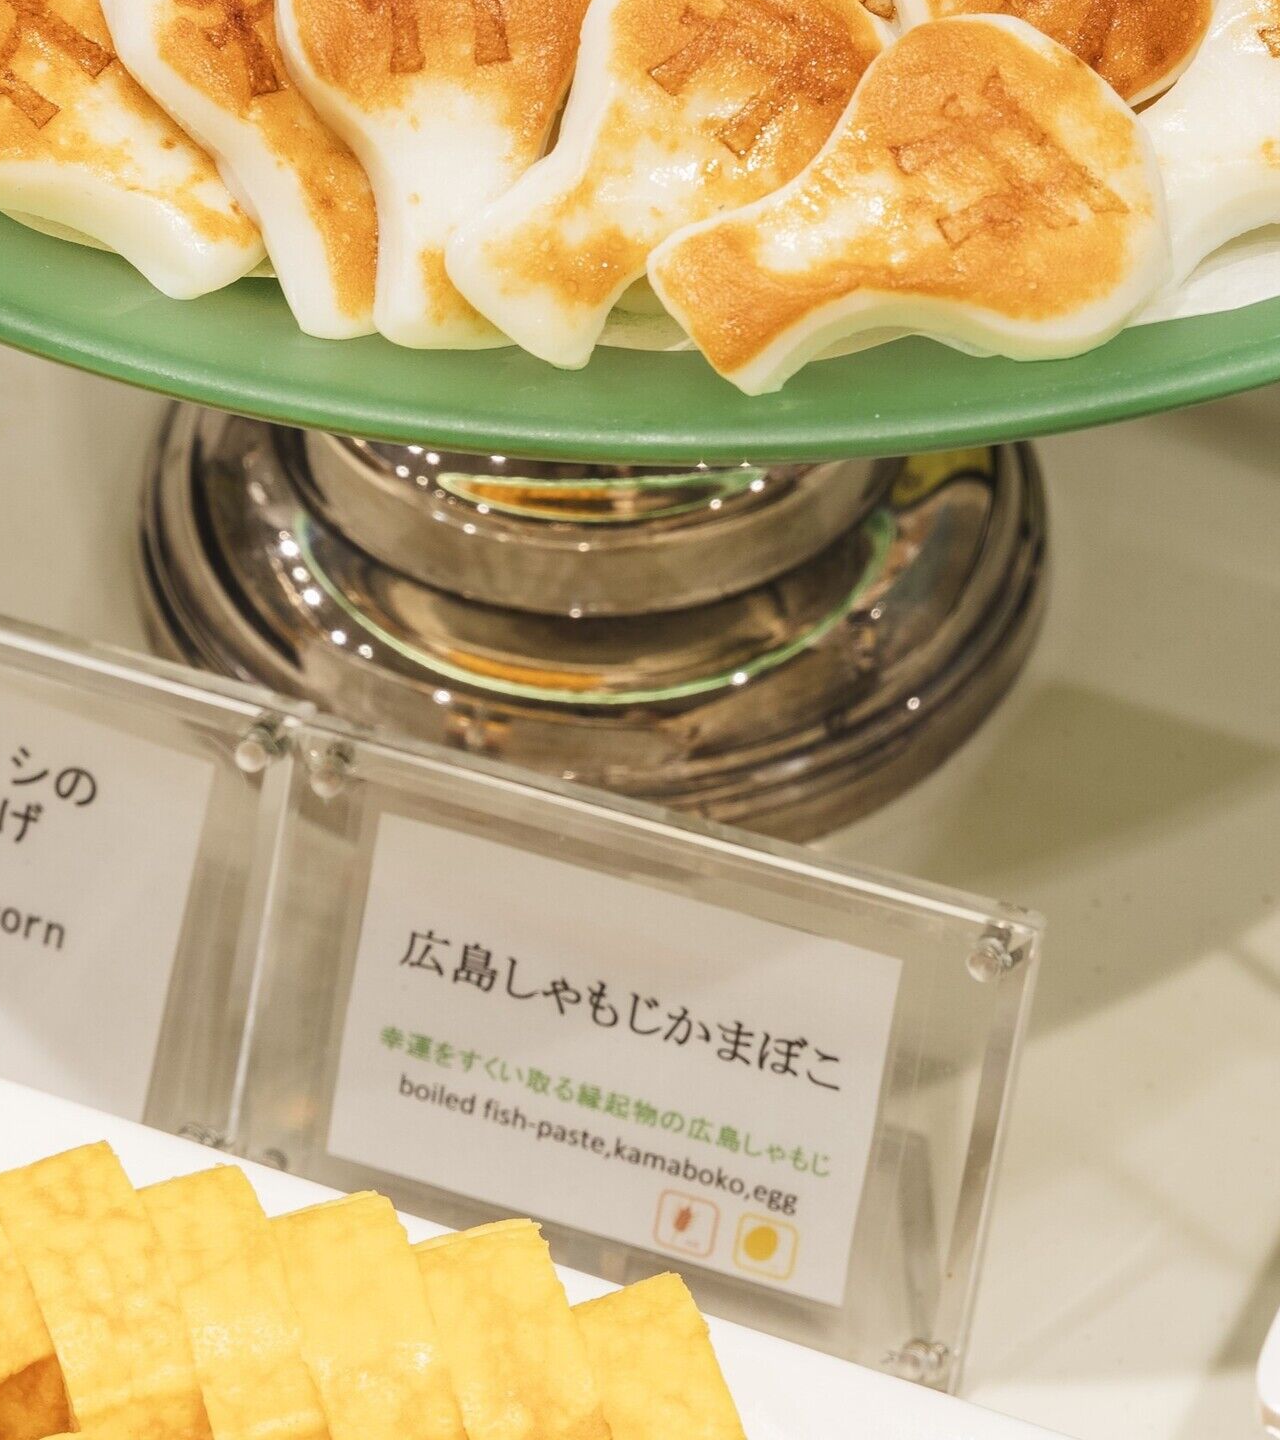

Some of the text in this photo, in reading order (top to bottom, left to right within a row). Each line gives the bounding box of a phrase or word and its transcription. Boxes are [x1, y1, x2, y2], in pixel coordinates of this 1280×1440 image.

[399, 929, 841, 1093] 広島しゃもじかまぼこ
[379, 1024, 831, 1178] 幸運をすくい取る縁起物の広島しゃもじ
[398, 1074, 476, 1116] boiled
